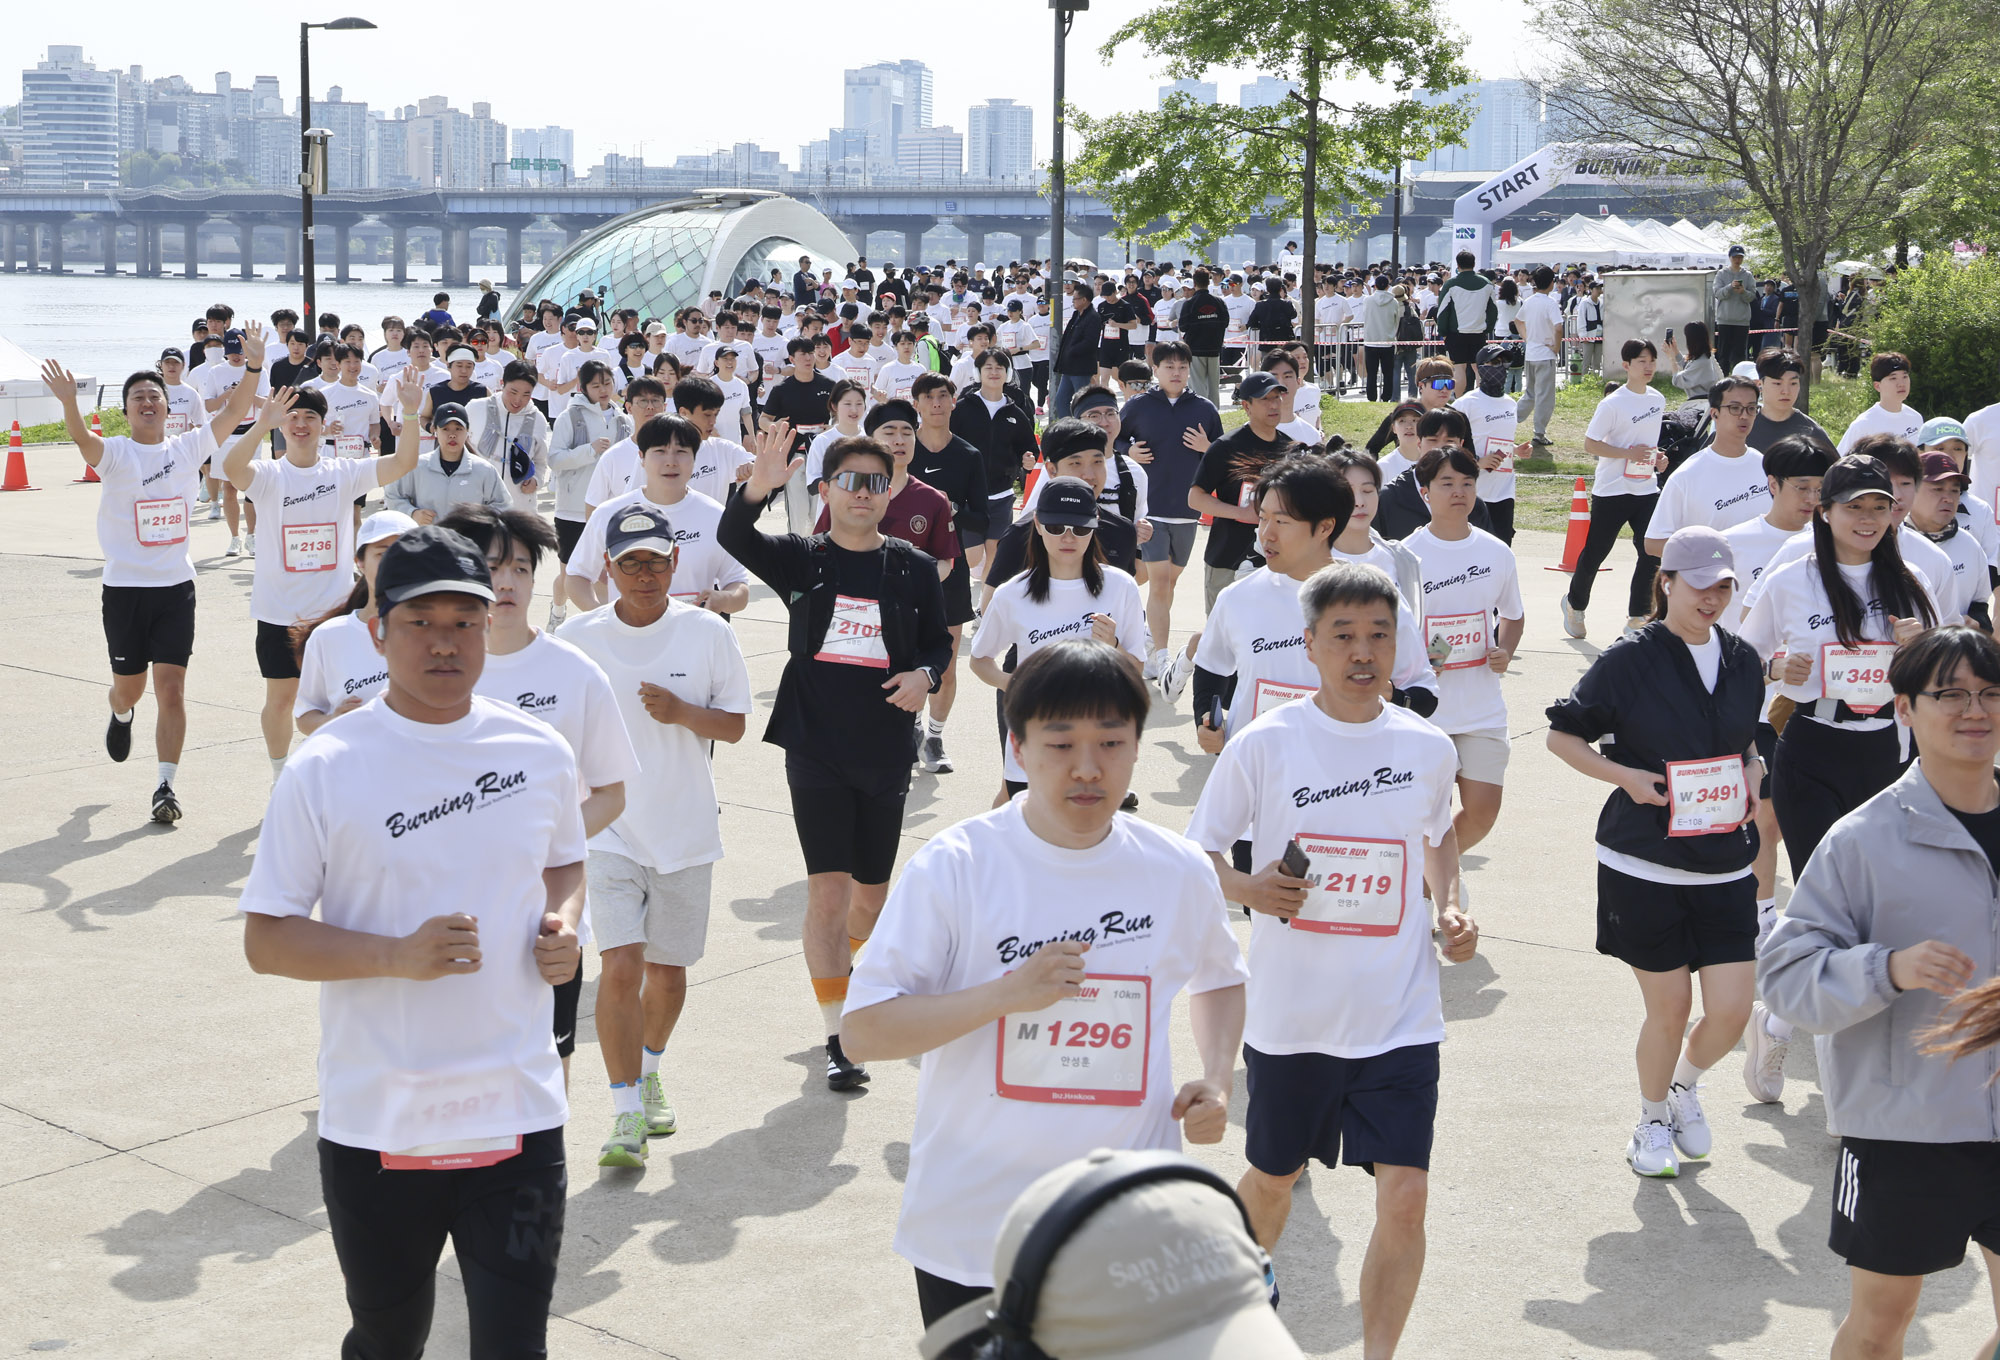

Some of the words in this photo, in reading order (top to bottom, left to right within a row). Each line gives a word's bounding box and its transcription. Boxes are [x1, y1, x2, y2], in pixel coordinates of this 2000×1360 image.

[1477, 163, 1540, 211] START
[1936, 426, 1961, 435] HOKA
[283, 491, 316, 507] Burning
[316, 483, 336, 496] Run
[1715, 491, 1749, 511] Burning
[1749, 484, 1770, 497] Run
[143, 518, 151, 526] M
[152, 514, 182, 526] 2128
[675, 530, 701, 542] Run
[300, 540, 331, 552] 2136
[1423, 573, 1467, 594] Burning
[1467, 565, 1491, 579] Run
[838, 621, 882, 637] 2107
[1028, 622, 1081, 645] Burning
[1446, 631, 1481, 646] 2210
[344, 671, 390, 694] Burnin
[1831, 671, 1844, 681] W
[517, 692, 558, 709] Run
[1262, 688, 1292, 699] BURNING
[1676, 766, 1709, 777] BURNING
[1710, 765, 1722, 774] RUN
[1292, 780, 1373, 808] Burning
[1373, 767, 1415, 789] Run
[1680, 791, 1693, 802] W
[1696, 784, 1739, 804] 3491
[385, 791, 477, 838] Burning
[475, 770, 527, 800] Run
[1677, 818, 1703, 826] E-108
[1305, 844, 1348, 855] BURNING
[1349, 847, 1370, 857] RUN
[1379, 850, 1400, 858] 10km
[1307, 873, 1322, 886] M
[1324, 872, 1392, 895] 2119
[1099, 910, 1154, 939] Run
[1113, 990, 1141, 1000] 10km
[1017, 1022, 1039, 1041] M
[1047, 1020, 1133, 1050] 1296
[1060, 1055, 1091, 1068] 안성훈
[1107, 1257, 1158, 1288] San
